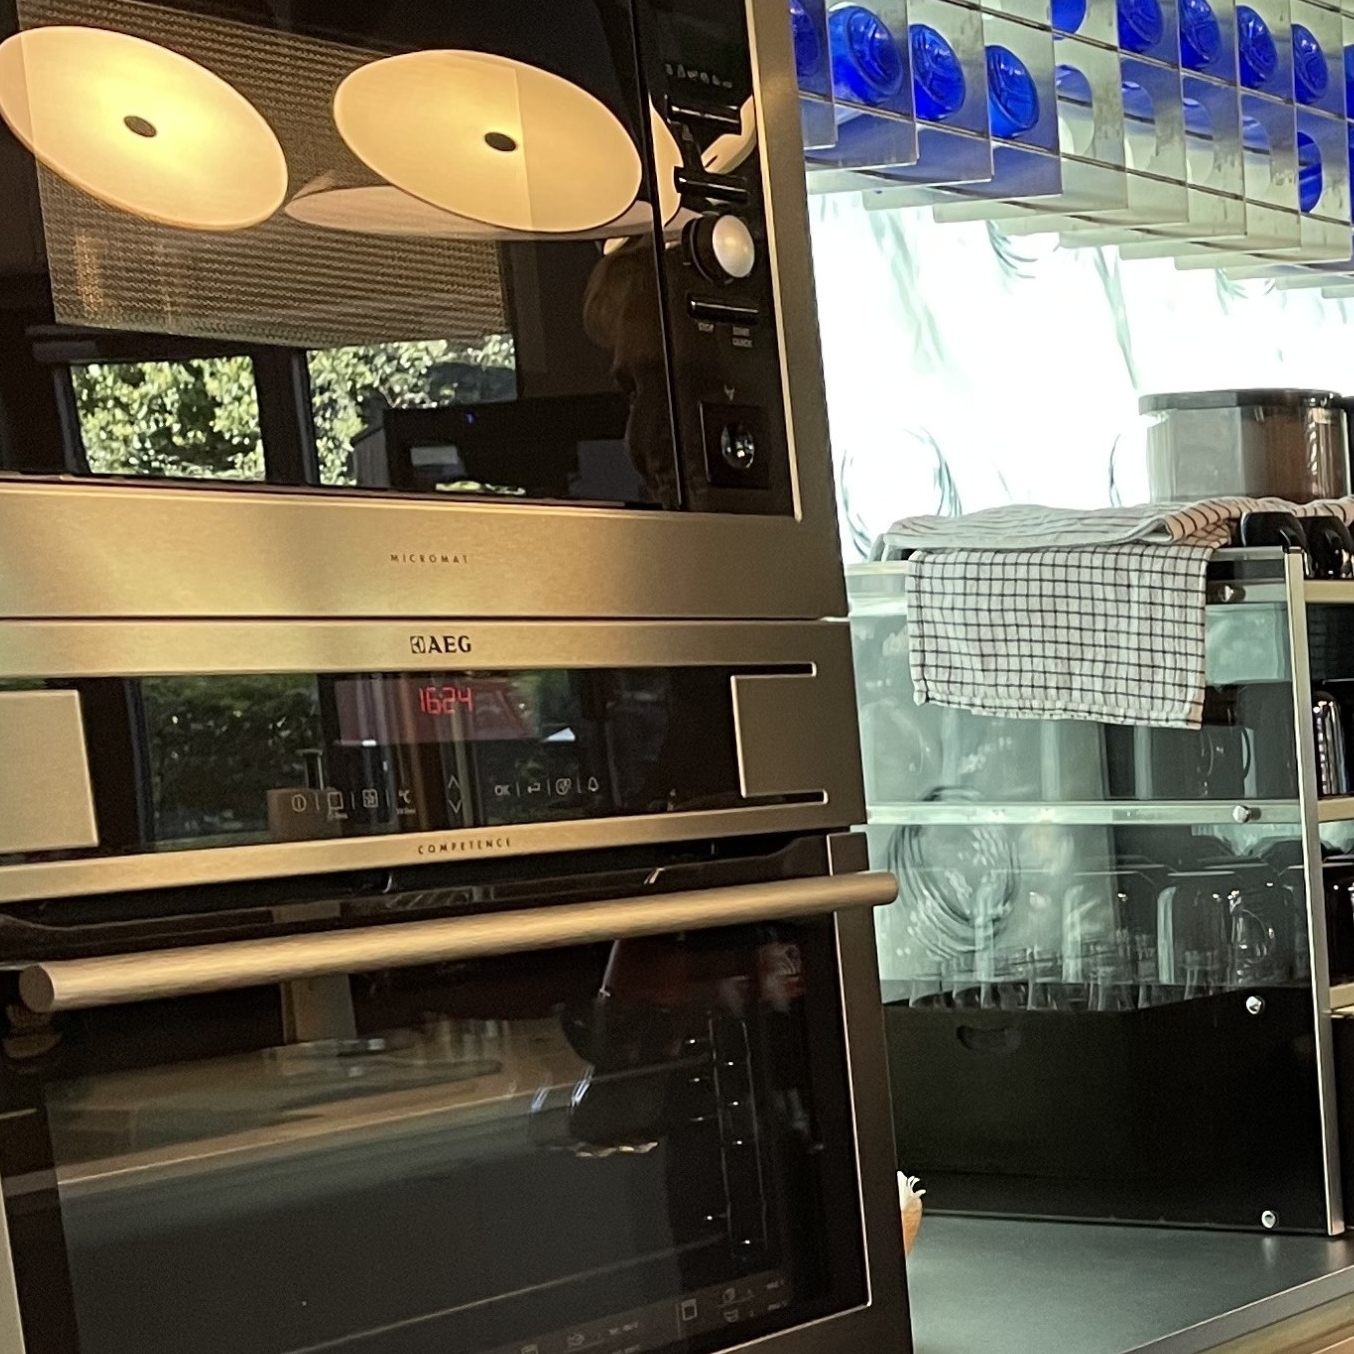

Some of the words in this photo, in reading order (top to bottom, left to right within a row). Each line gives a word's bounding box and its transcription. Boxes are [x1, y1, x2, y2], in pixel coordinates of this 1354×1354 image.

[390, 554, 468, 564] MICROMAT
[428, 635, 472, 653] AEG
[418, 838, 511, 855] COMPETENCE
